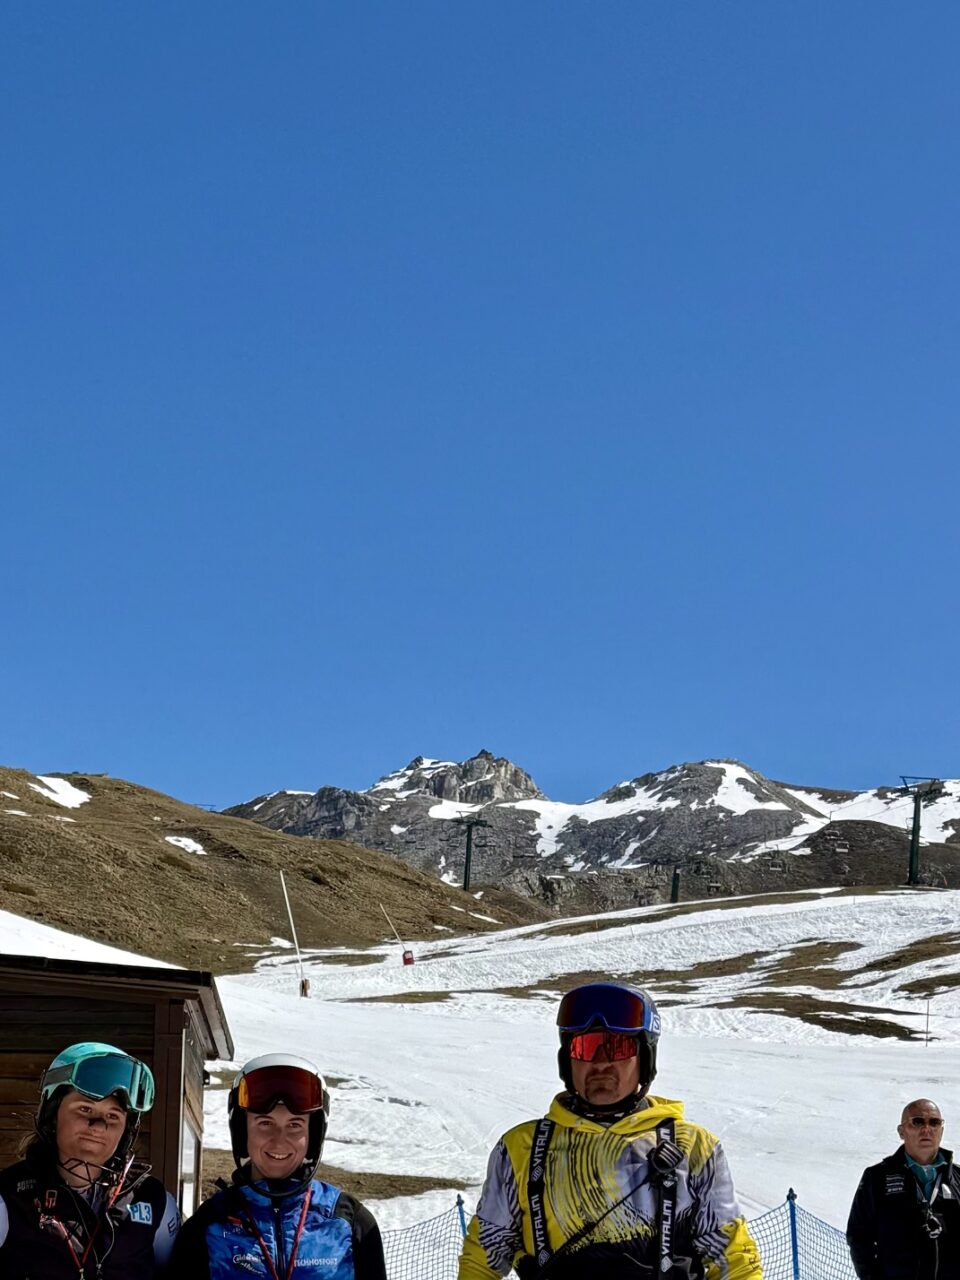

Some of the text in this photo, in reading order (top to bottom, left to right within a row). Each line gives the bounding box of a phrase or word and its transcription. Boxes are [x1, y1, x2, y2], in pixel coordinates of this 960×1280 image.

[532, 1120, 552, 1167] VITALIN
[130, 1203, 150, 1222] PL3
[531, 1194, 545, 1250] VITALINI
[661, 1199, 672, 1255] VITALINI
